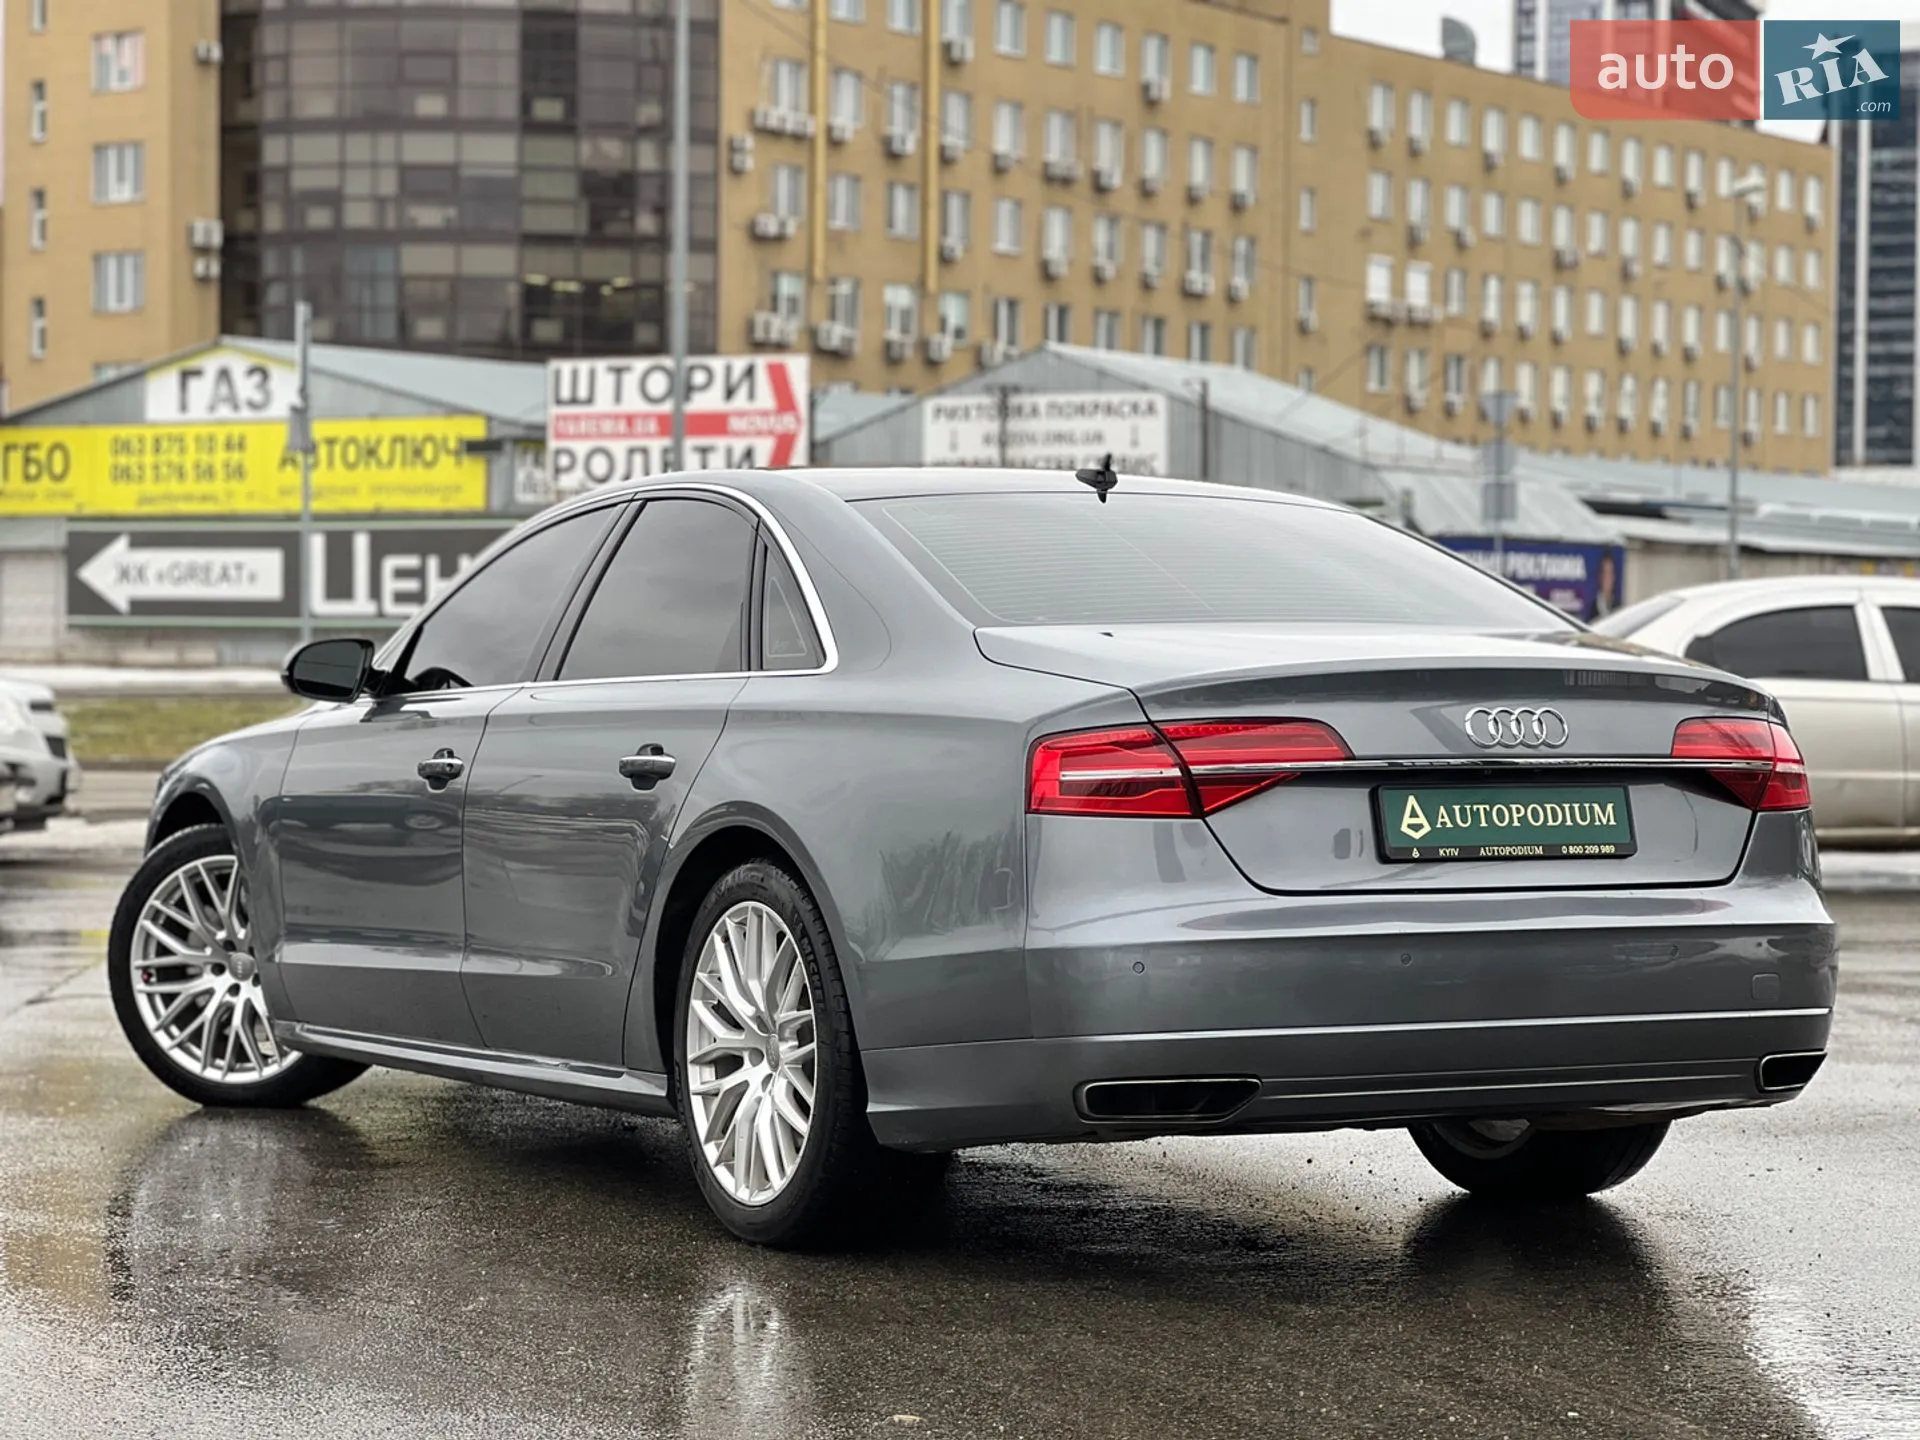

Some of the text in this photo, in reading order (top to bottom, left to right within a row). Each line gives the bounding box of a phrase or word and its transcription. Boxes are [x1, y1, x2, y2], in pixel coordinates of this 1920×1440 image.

[180, 366, 271, 414] ГАЗ
[554, 362, 756, 405] ШТОРИ
[3, 441, 71, 484] ГБО
[1436, 803, 1617, 828] AUTOPODIUM
[1438, 847, 1459, 857] KYIV
[1479, 846, 1543, 856] AUTOPODIUM
[1569, 845, 1583, 855] 800
[1585, 845, 1599, 854] 209
